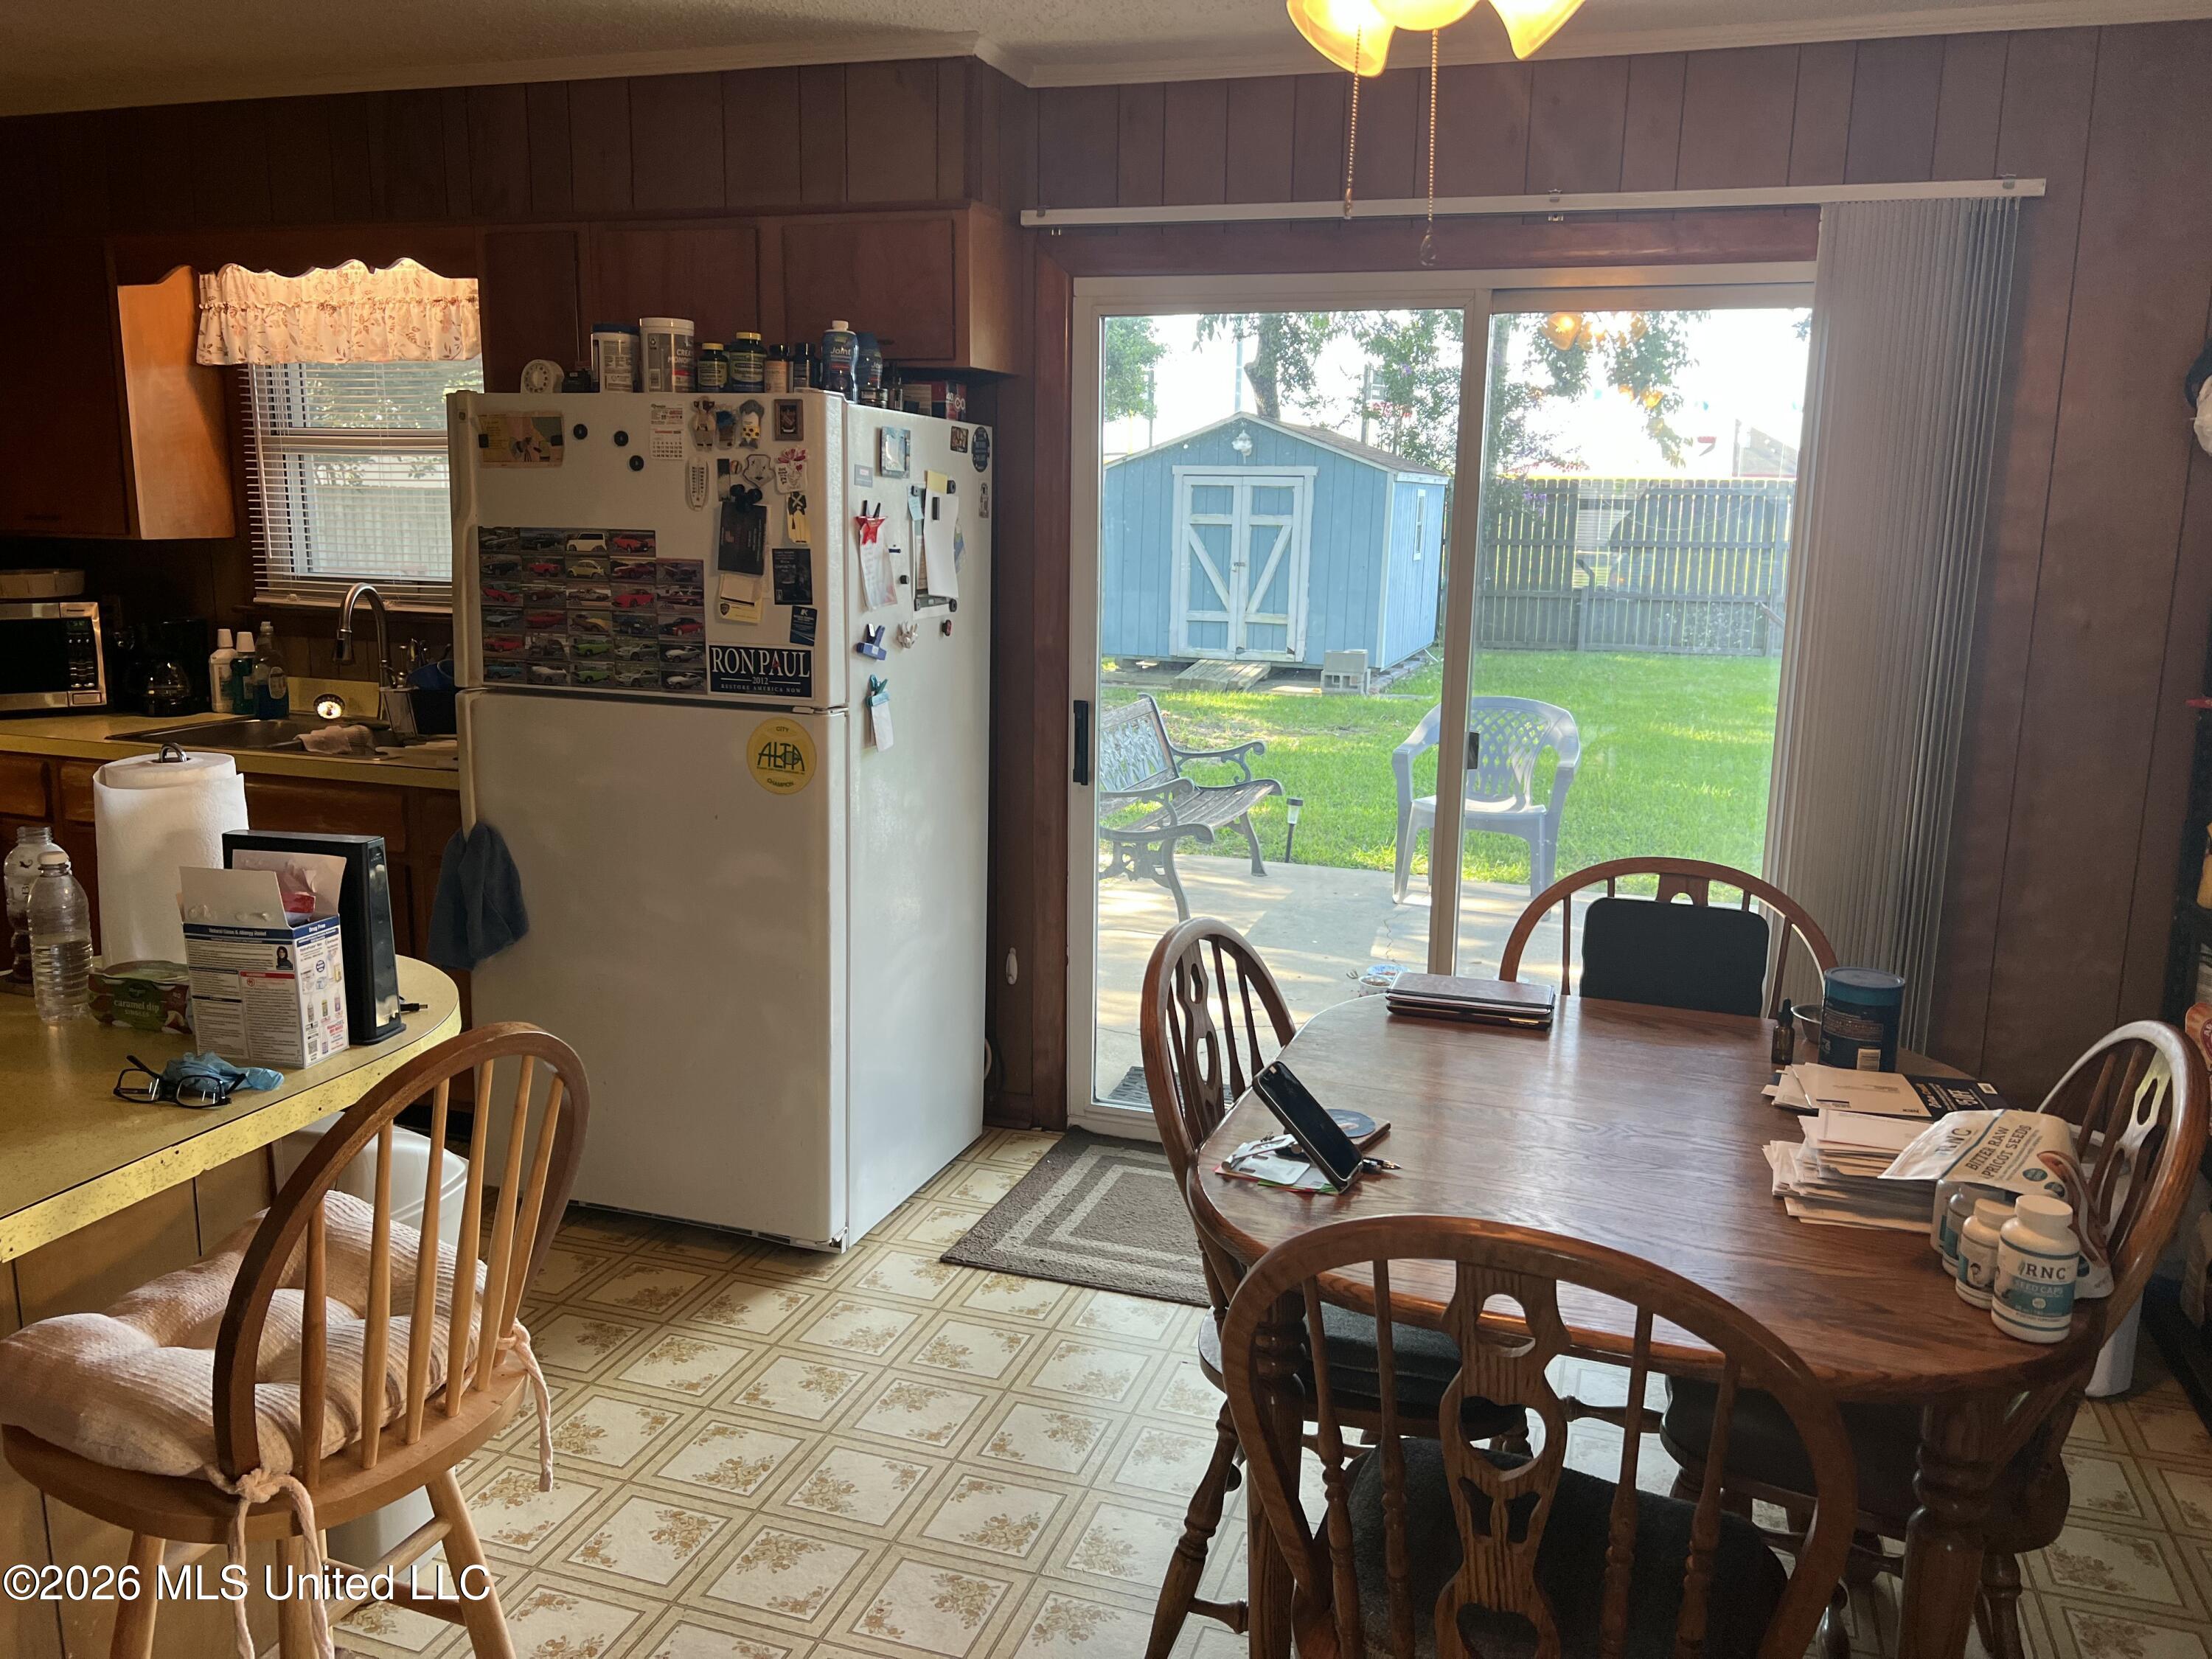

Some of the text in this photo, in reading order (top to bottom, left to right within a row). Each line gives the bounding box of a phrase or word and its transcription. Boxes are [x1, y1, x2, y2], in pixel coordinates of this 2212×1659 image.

[676, 349, 692, 357] CREA
[830, 347, 851, 355] Joint
[712, 647, 810, 677] RON PAUL
[752, 677, 768, 685] 2012
[757, 742, 805, 772] ALTA
[114, 1000, 159, 1013] caramel dip
[2006, 1124, 2032, 1150] SEEDS
[1966, 1126, 2010, 1171] BITTER RAW
[2026, 1263, 2066, 1280] RNC
